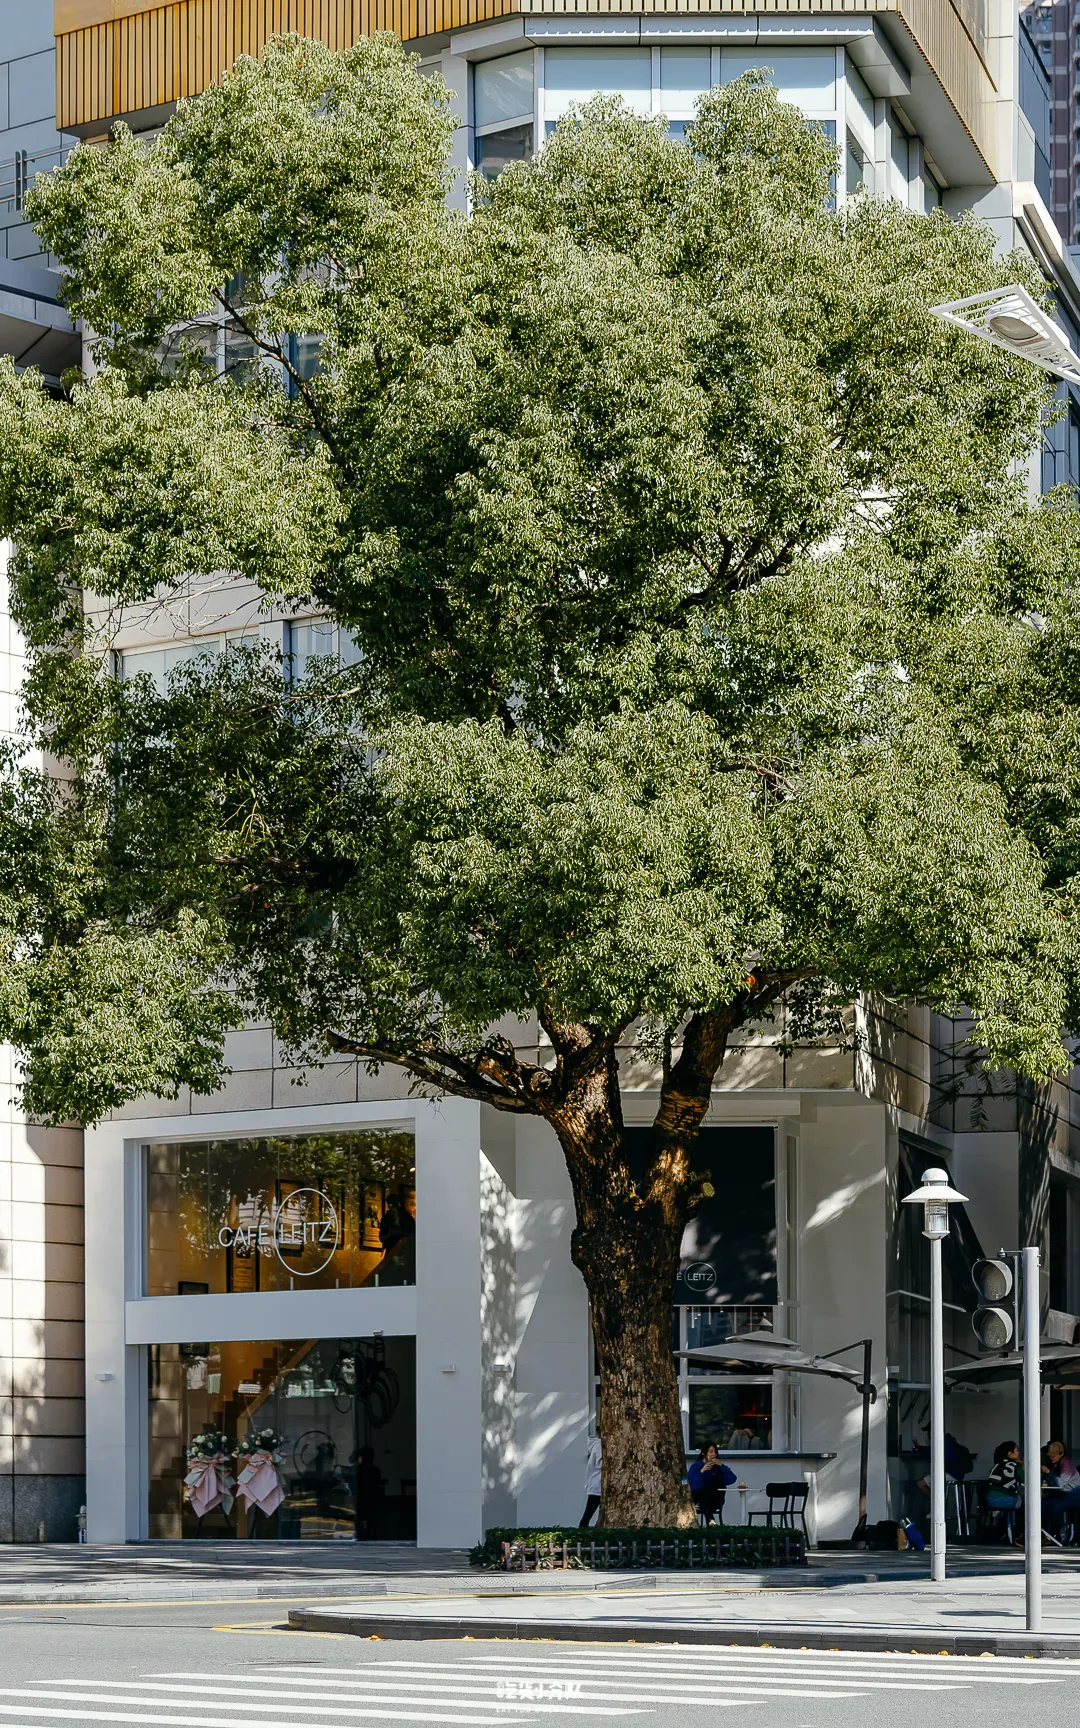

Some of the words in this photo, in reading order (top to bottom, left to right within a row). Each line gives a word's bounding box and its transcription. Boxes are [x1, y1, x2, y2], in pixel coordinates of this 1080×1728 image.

[218, 1220, 270, 1247] CAFÉ
[279, 1221, 333, 1244] LEITZ
[687, 1273, 714, 1281] LEITZ
